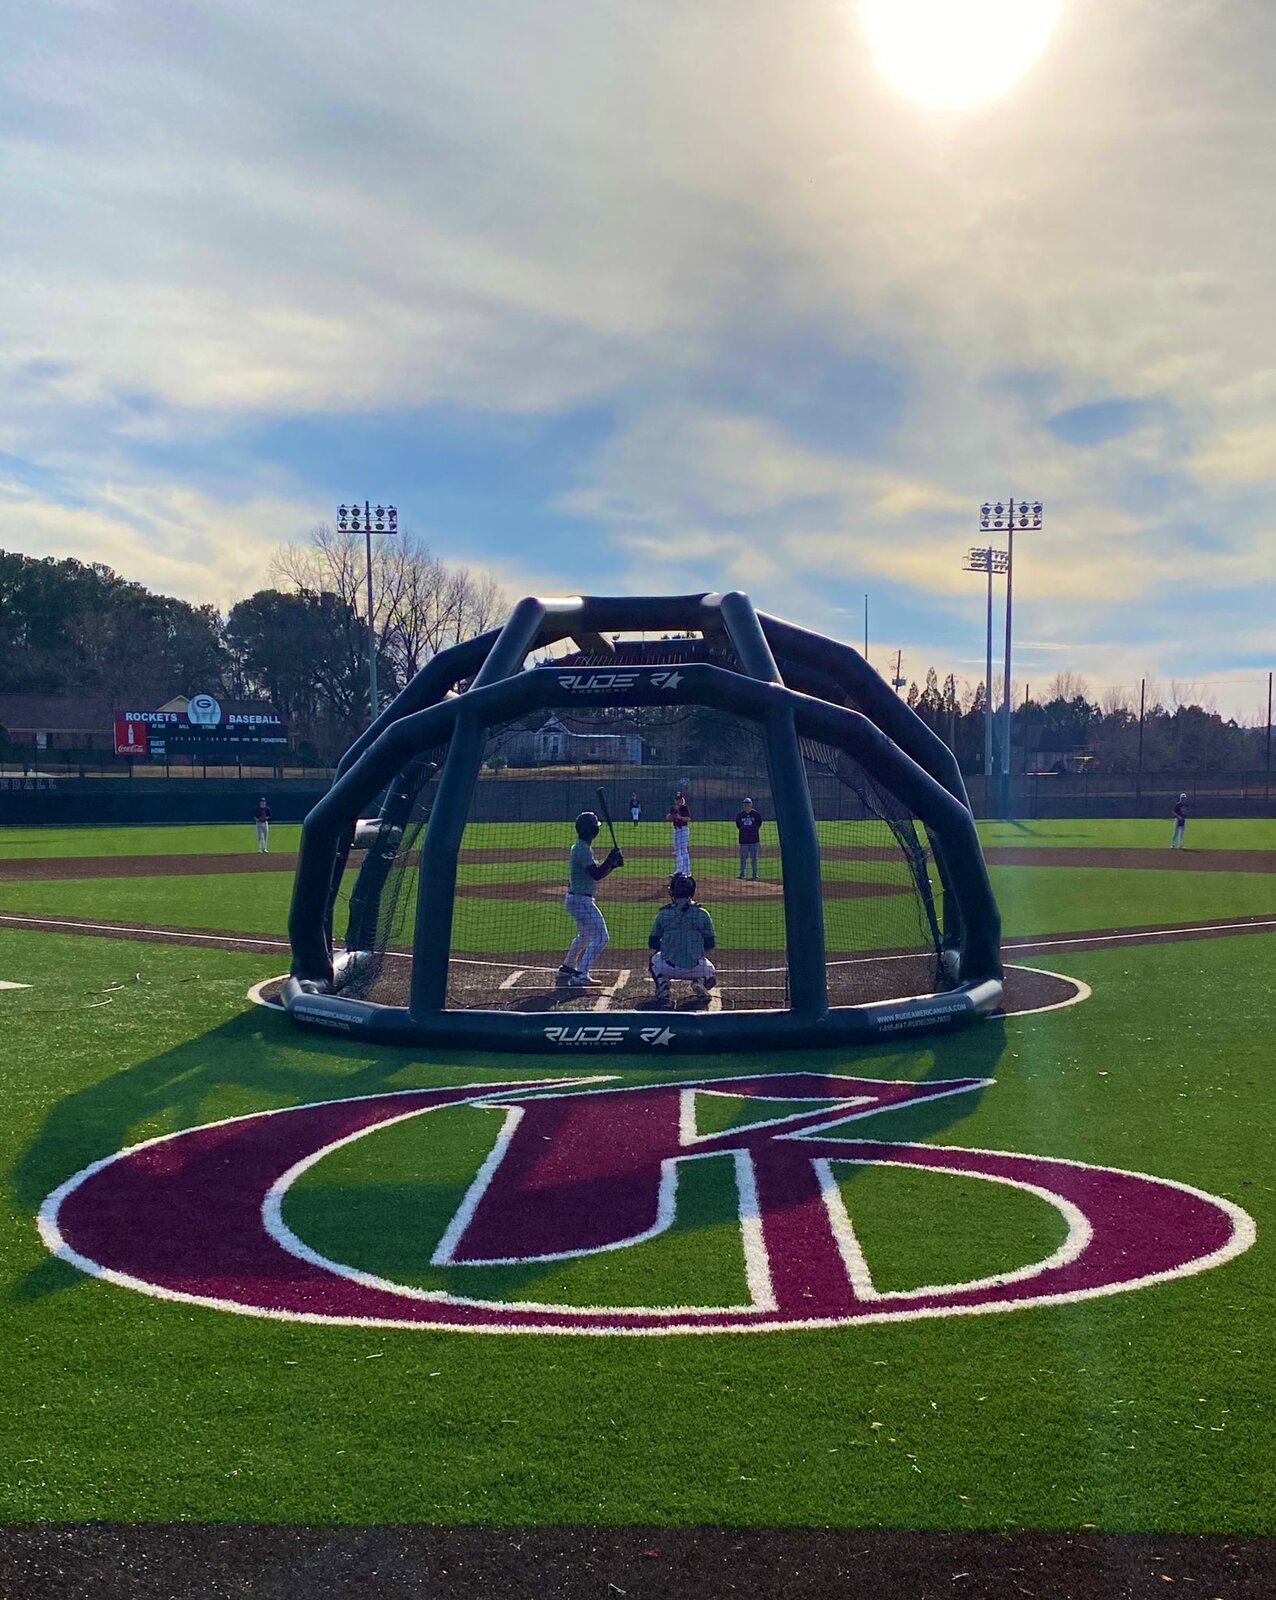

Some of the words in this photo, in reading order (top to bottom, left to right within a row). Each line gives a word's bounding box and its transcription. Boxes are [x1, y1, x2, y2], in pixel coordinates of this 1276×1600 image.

[557, 673, 640, 690] RUDE
[196, 699, 212, 709] G
[125, 712, 178, 722] ROCKETS
[229, 714, 281, 724] BASEBALL
[117, 744, 144, 753] Coca-Cola
[543, 1026, 630, 1042] RUDE
